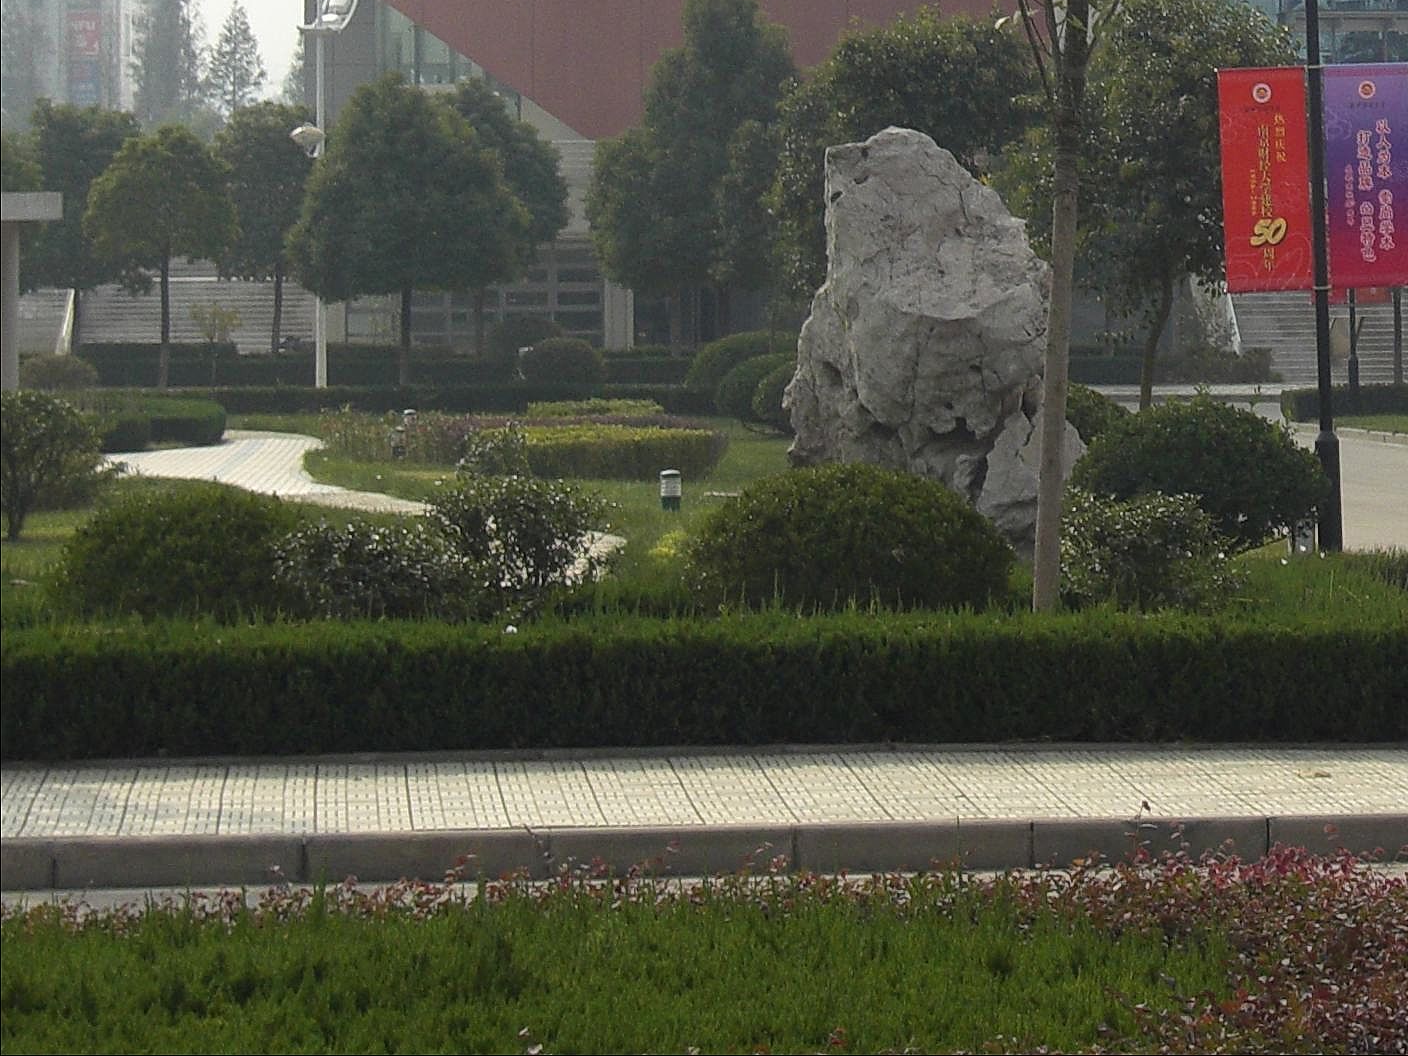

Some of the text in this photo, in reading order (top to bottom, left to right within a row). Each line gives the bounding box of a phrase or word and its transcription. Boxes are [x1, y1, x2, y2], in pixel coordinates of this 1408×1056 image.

[1375, 118, 1392, 179] 以人为本
[1250, 218, 1287, 246] 50
